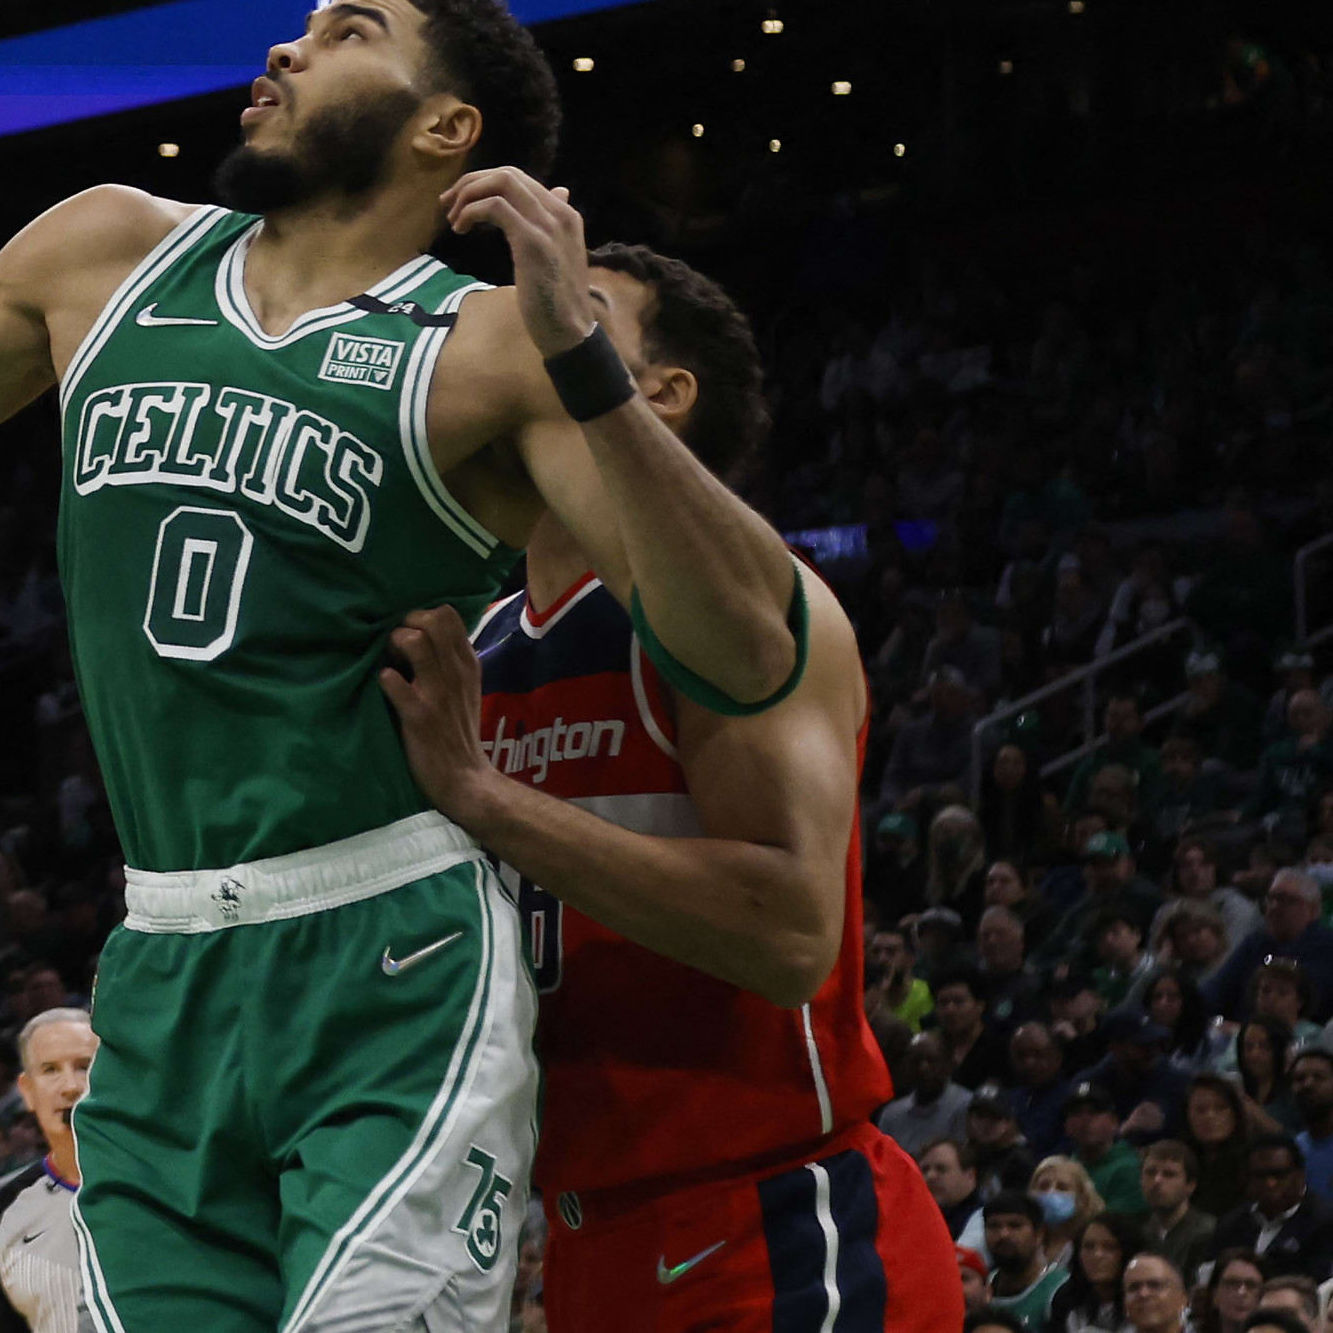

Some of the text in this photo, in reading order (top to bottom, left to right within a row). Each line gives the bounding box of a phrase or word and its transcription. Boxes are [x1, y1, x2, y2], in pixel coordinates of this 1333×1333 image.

[326, 364, 368, 380] PRINT
[337, 339, 393, 367] VISTA
[73, 382, 383, 553] CELTICS
[143, 506, 254, 661] 0
